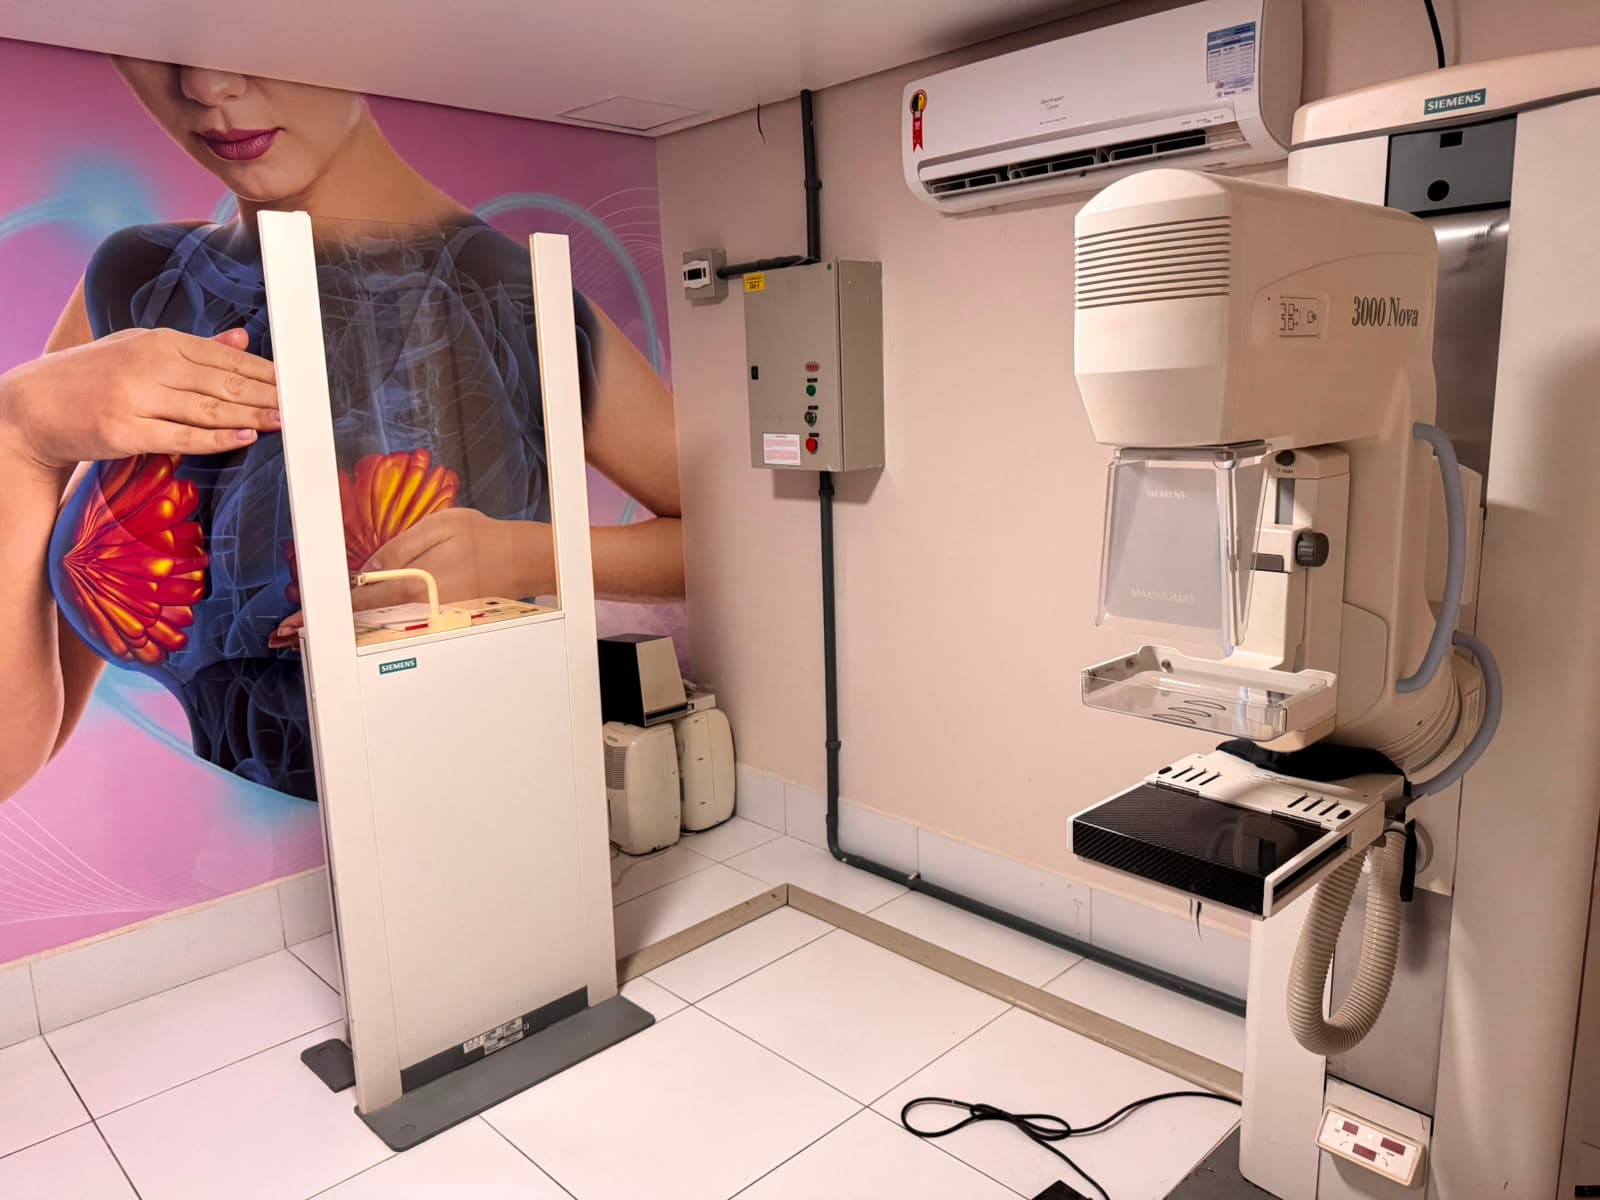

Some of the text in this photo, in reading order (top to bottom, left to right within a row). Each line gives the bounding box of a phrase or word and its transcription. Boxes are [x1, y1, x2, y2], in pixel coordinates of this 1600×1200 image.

[1427, 93, 1481, 110] SIEMENS
[1352, 296, 1419, 327] 3000 Nova
[1146, 489, 1186, 499] SIEMENS
[381, 659, 415, 673] SIEMENS
